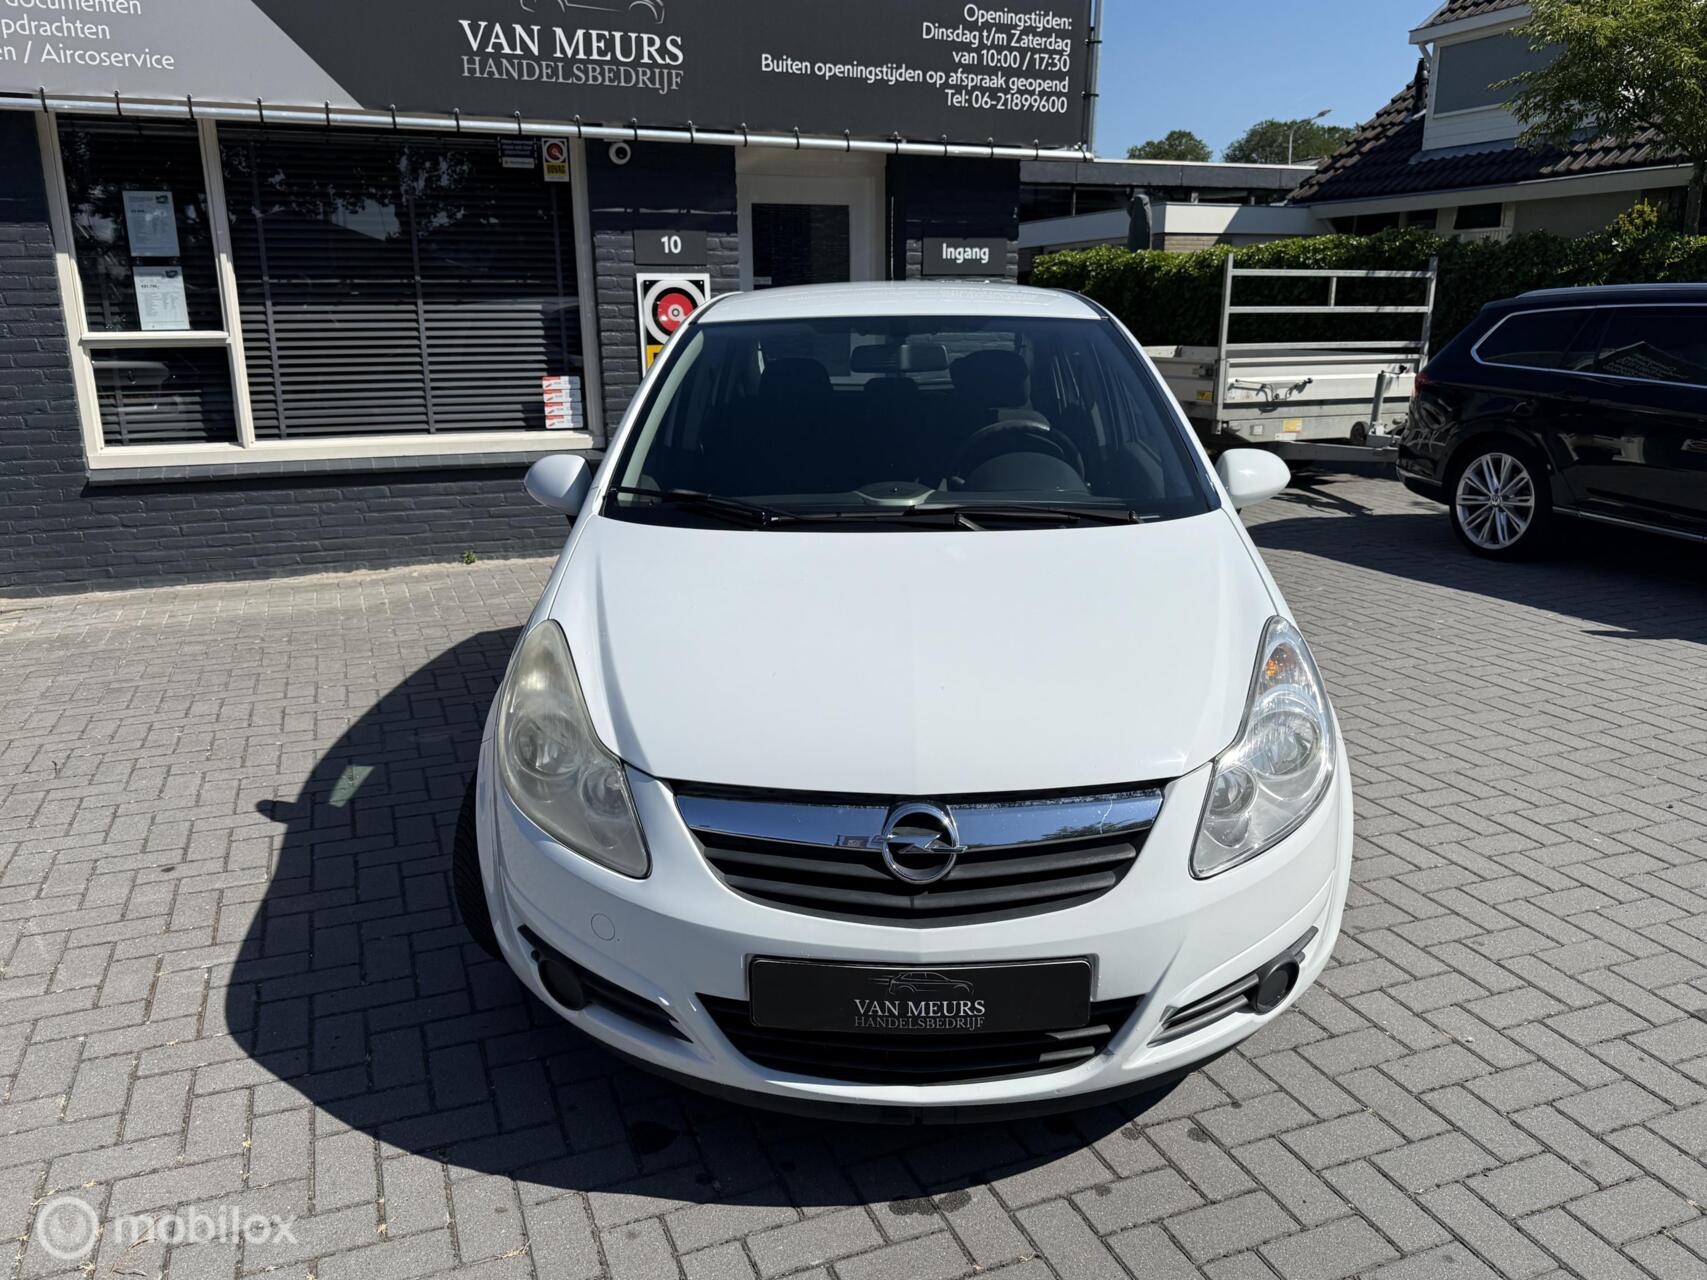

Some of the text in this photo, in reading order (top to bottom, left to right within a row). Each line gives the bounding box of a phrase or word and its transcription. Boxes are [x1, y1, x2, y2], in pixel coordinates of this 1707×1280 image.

[5, 0, 142, 15] ocumenten
[964, 4, 1072, 31] Openingstijden:
[1, 13, 111, 40] pdrachten
[922, 22, 1071, 55] Dinsdag t/m Zaterdag
[458, 19, 684, 65] VAN MEURS
[0, 40, 175, 70] n / Aircoservice
[952, 49, 1070, 72] van 10:00 / 17:30
[461, 55, 684, 94] HANDELSBEDRIJF
[761, 53, 1069, 95] Buiten openingstijden op afspraak geopend
[944, 89, 1068, 113] Tel: 06-21899600
[661, 235, 682, 254] 10
[942, 242, 990, 264] Ingang
[854, 999, 985, 1016] VAN MEURS
[855, 1016, 985, 1031] HANDELSBEDRIJF
